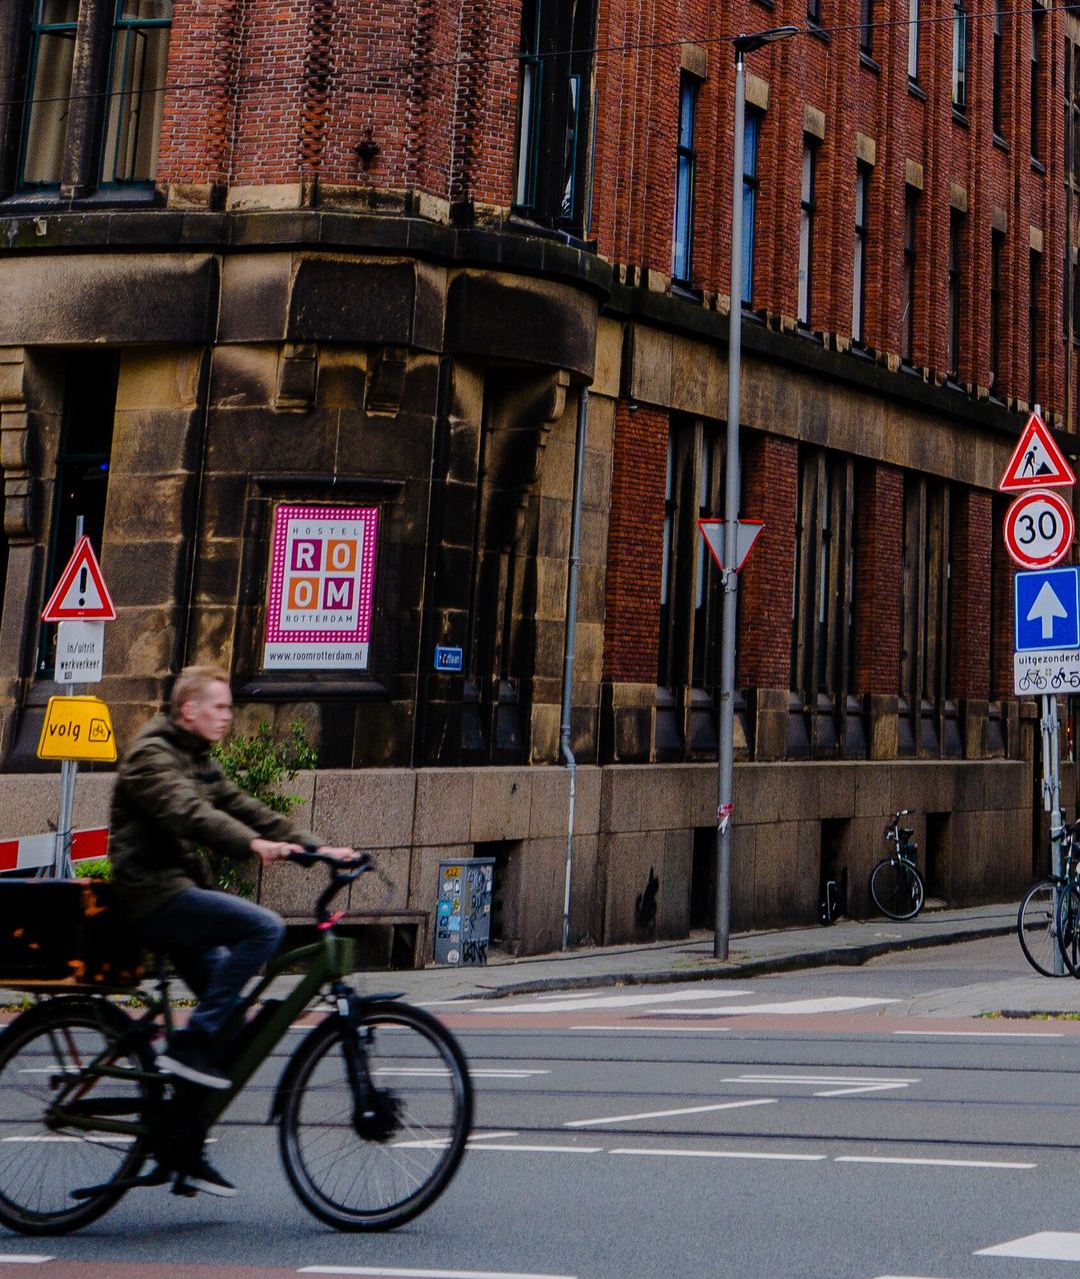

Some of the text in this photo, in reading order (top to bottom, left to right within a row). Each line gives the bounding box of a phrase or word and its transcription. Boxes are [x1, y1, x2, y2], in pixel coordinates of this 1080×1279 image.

[292, 526, 359, 537] HOSTEL
[1018, 510, 1058, 545] 30
[285, 614, 354, 624] ROTTERDAM
[269, 650, 363, 662] www.roomrotterdam.nl
[1018, 653, 1080, 666] uitgezonderd
[60, 658, 100, 671] werkverkeer
[50, 720, 81, 742] volg
